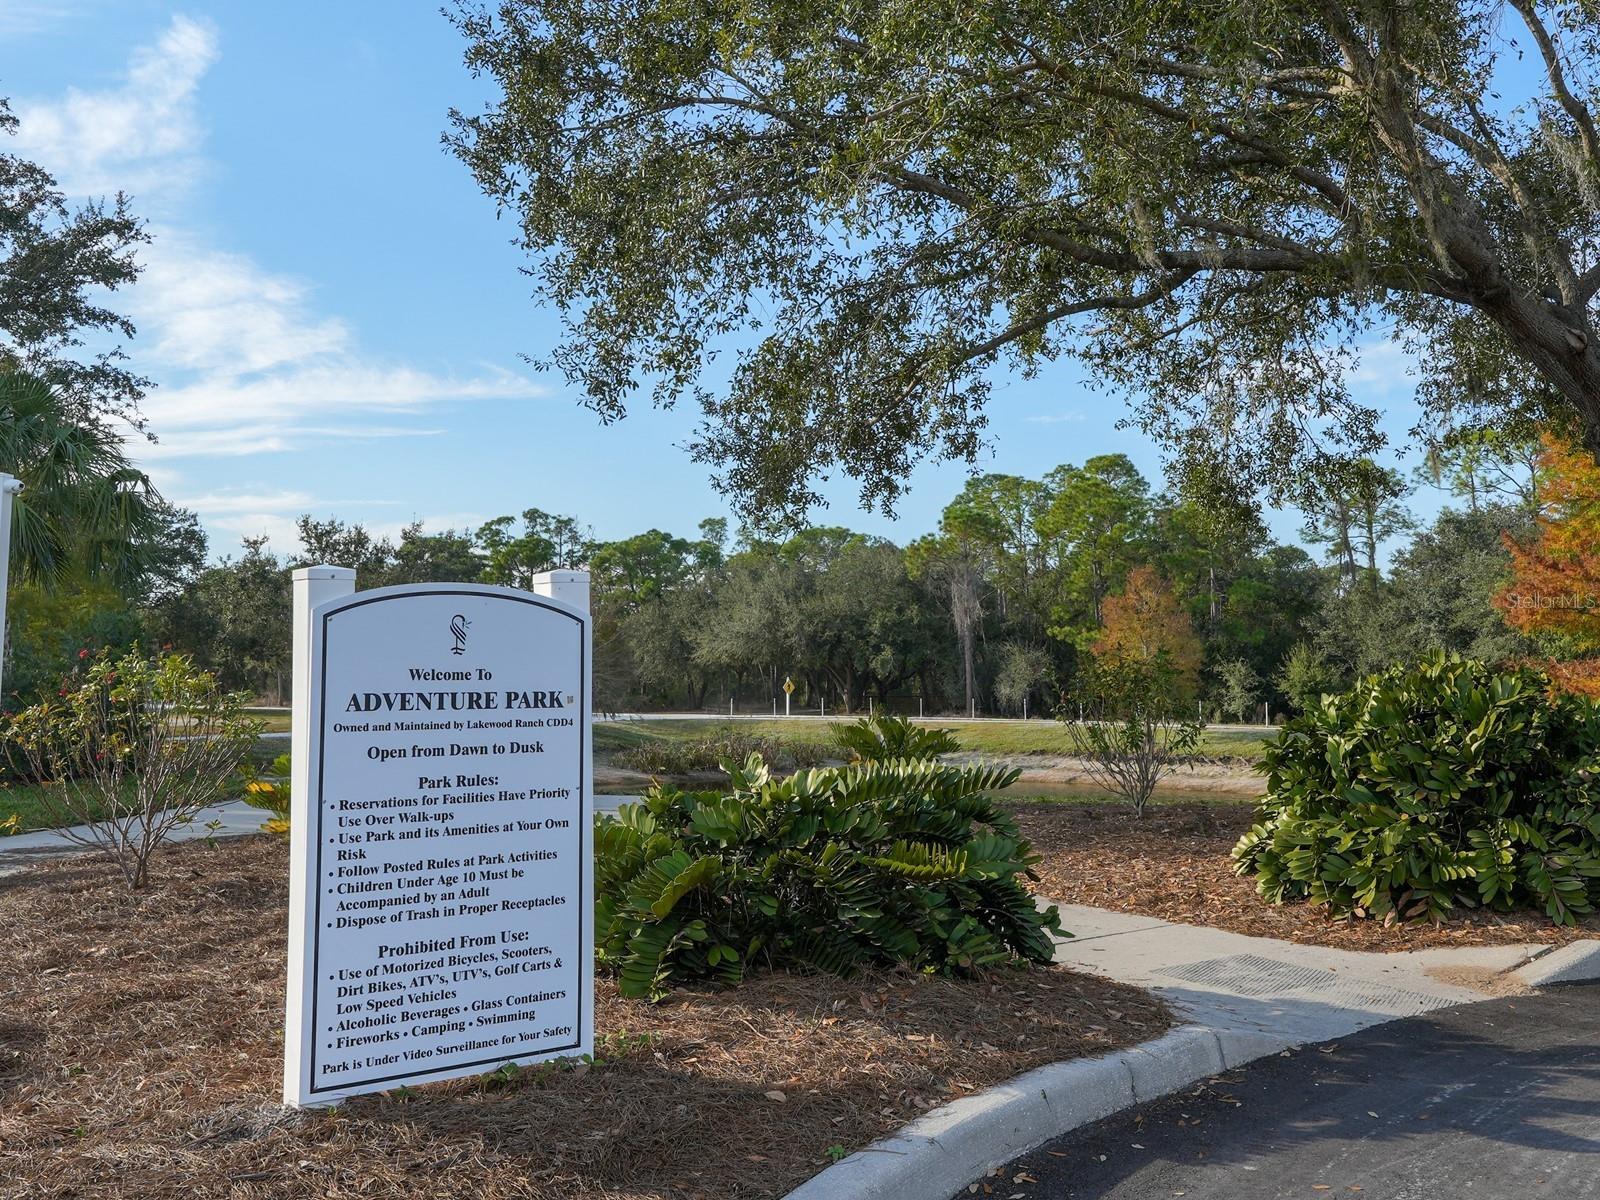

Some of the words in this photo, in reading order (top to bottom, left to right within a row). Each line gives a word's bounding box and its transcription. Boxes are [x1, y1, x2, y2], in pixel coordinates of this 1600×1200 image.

[408, 668, 472, 681] Welcome
[475, 668, 492, 681] To
[345, 691, 498, 712] ADVENTURE
[505, 691, 564, 709] PARK
[333, 723, 369, 733] Owned
[372, 722, 391, 732] and
[394, 721, 451, 731] Maintained
[453, 721, 464, 732] by
[467, 719, 513, 729] Lakewood
[515, 719, 544, 728] Ranch
[546, 718, 573, 727] CDD4
[367, 746, 407, 762] Open
[411, 744, 445, 758] from
[449, 743, 488, 756] Dawn
[492, 743, 506, 755] to
[509, 741, 544, 754] Dusk
[418, 776, 452, 790] Park
[456, 774, 499, 788] Rules:
[339, 796, 418, 811] Reservations
[421, 795, 439, 806] for
[442, 792, 495, 805] Facilities
[498, 791, 526, 801] Have
[529, 787, 570, 800] Priority
[338, 816, 361, 828] Use
[365, 814, 395, 826] Over
[398, 811, 454, 823] Walk-ups
[339, 833, 362, 844] Use
[366, 830, 395, 842] Park
[398, 828, 421, 840] and
[425, 827, 439, 838] its
[442, 823, 500, 837] Amenities
[503, 822, 514, 832] at
[516, 820, 542, 831] Your
[545, 818, 569, 829] Own
[337, 848, 367, 861] Risk
[338, 865, 380, 878] Follow
[383, 860, 423, 874] Posted
[427, 858, 460, 870] Rules
[463, 856, 475, 867] at
[478, 853, 505, 866] Park
[507, 849, 558, 863] Activities
[337, 881, 393, 895] Children
[397, 876, 435, 889] Under
[437, 874, 459, 887] Age
[463, 871, 476, 883] 10
[479, 869, 508, 881] Must
[511, 868, 524, 878] be
[336, 893, 420, 912] Accompanied
[424, 892, 437, 905] by
[440, 892, 455, 901] an
[458, 886, 490, 899] Adult
[336, 915, 387, 929] Dispose
[390, 910, 404, 923] of
[405, 907, 440, 921] Trash
[443, 906, 455, 917] in
[459, 903, 498, 916] Proper
[501, 895, 566, 911] Receptacles
[378, 937, 456, 959] Prohibited
[460, 935, 496, 949] From
[500, 930, 529, 943] Use:
[339, 969, 362, 981] Use
[365, 965, 380, 977] of
[382, 957, 444, 975] Motorized
[448, 952, 498, 967] Bicycles,
[501, 946, 552, 960] Scooters,
[337, 984, 364, 998] Dirt
[368, 981, 406, 994] Bikes,
[494, 963, 520, 976] Golf
[522, 960, 551, 973] Carts
[554, 957, 562, 968] &
[336, 1013, 397, 1032] Alcoholic
[400, 1005, 460, 1022] Beverages
[471, 999, 503, 1012] Glass
[506, 990, 566, 1006] Containers
[337, 1003, 363, 1015] Low
[366, 995, 404, 1012] Speed
[407, 989, 457, 1004] Vehicles
[336, 1030, 400, 1049] Fireworks
[411, 1020, 466, 1037] Camping
[476, 1009, 536, 1027] Swimming
[322, 1061, 350, 1074] Park
[353, 1059, 362, 1070] is
[366, 1054, 400, 1067] Under
[403, 1049, 433, 1061] Video
[435, 1038, 499, 1056] Surveillance
[502, 1035, 516, 1045] for
[518, 1031, 541, 1042] Your
[543, 1026, 572, 1038] Safety
